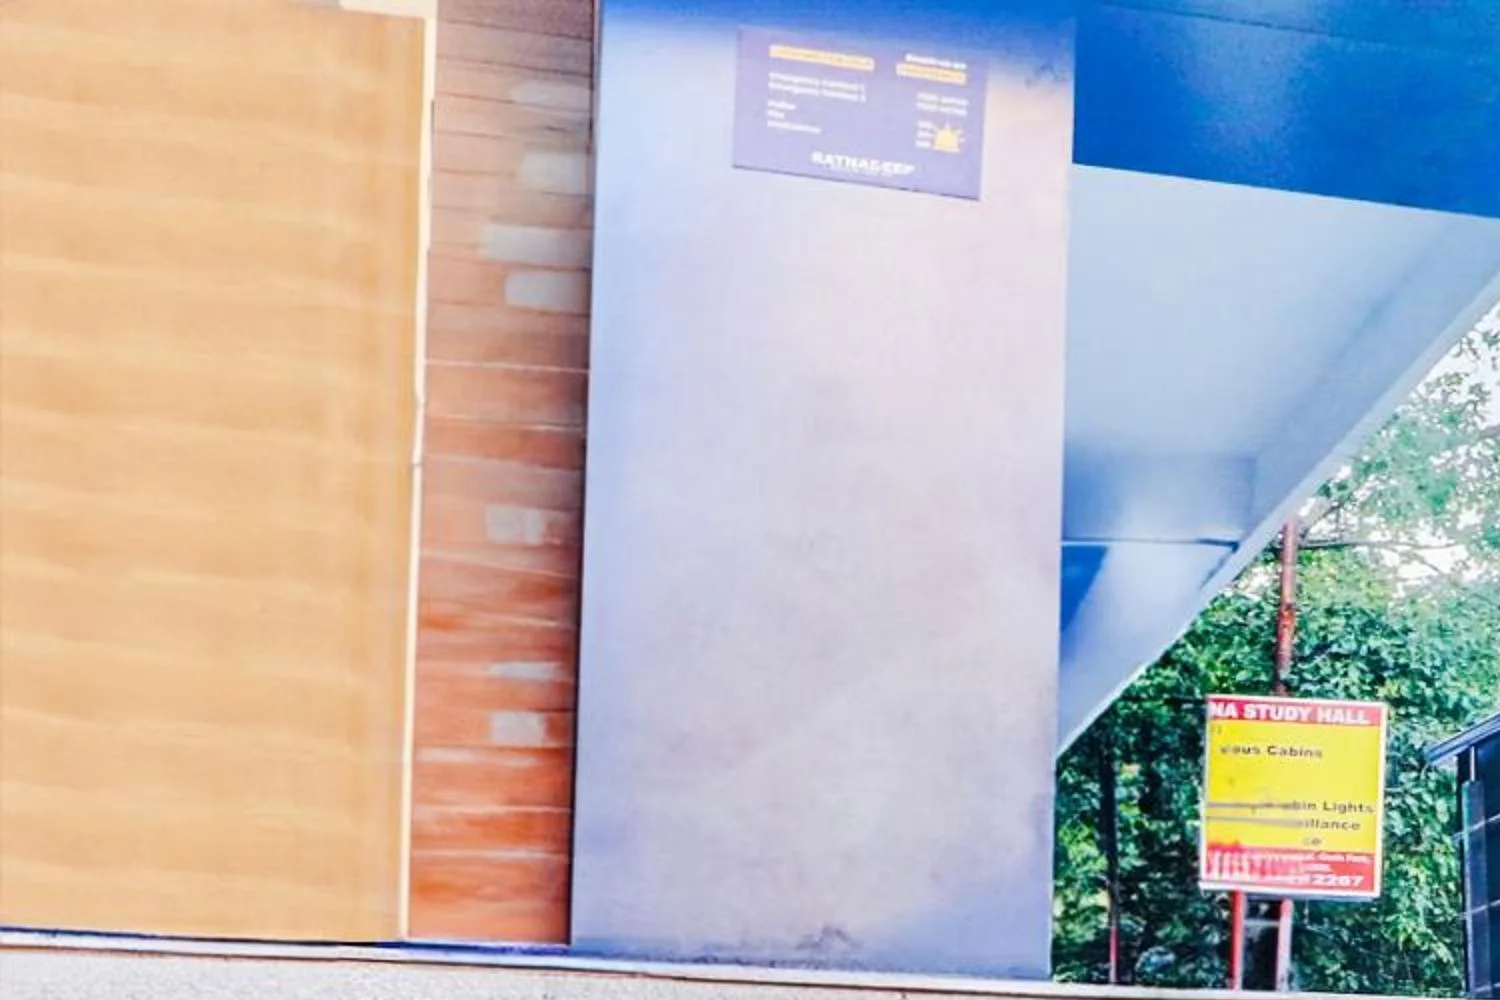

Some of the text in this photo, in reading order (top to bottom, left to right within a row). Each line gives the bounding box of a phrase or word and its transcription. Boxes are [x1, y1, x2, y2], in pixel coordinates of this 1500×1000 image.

[1244, 703, 1313, 721] STUDY
[1317, 707, 1371, 725] HALL
[1266, 745, 1323, 759] Cabins
[1322, 800, 1375, 814] Lights
